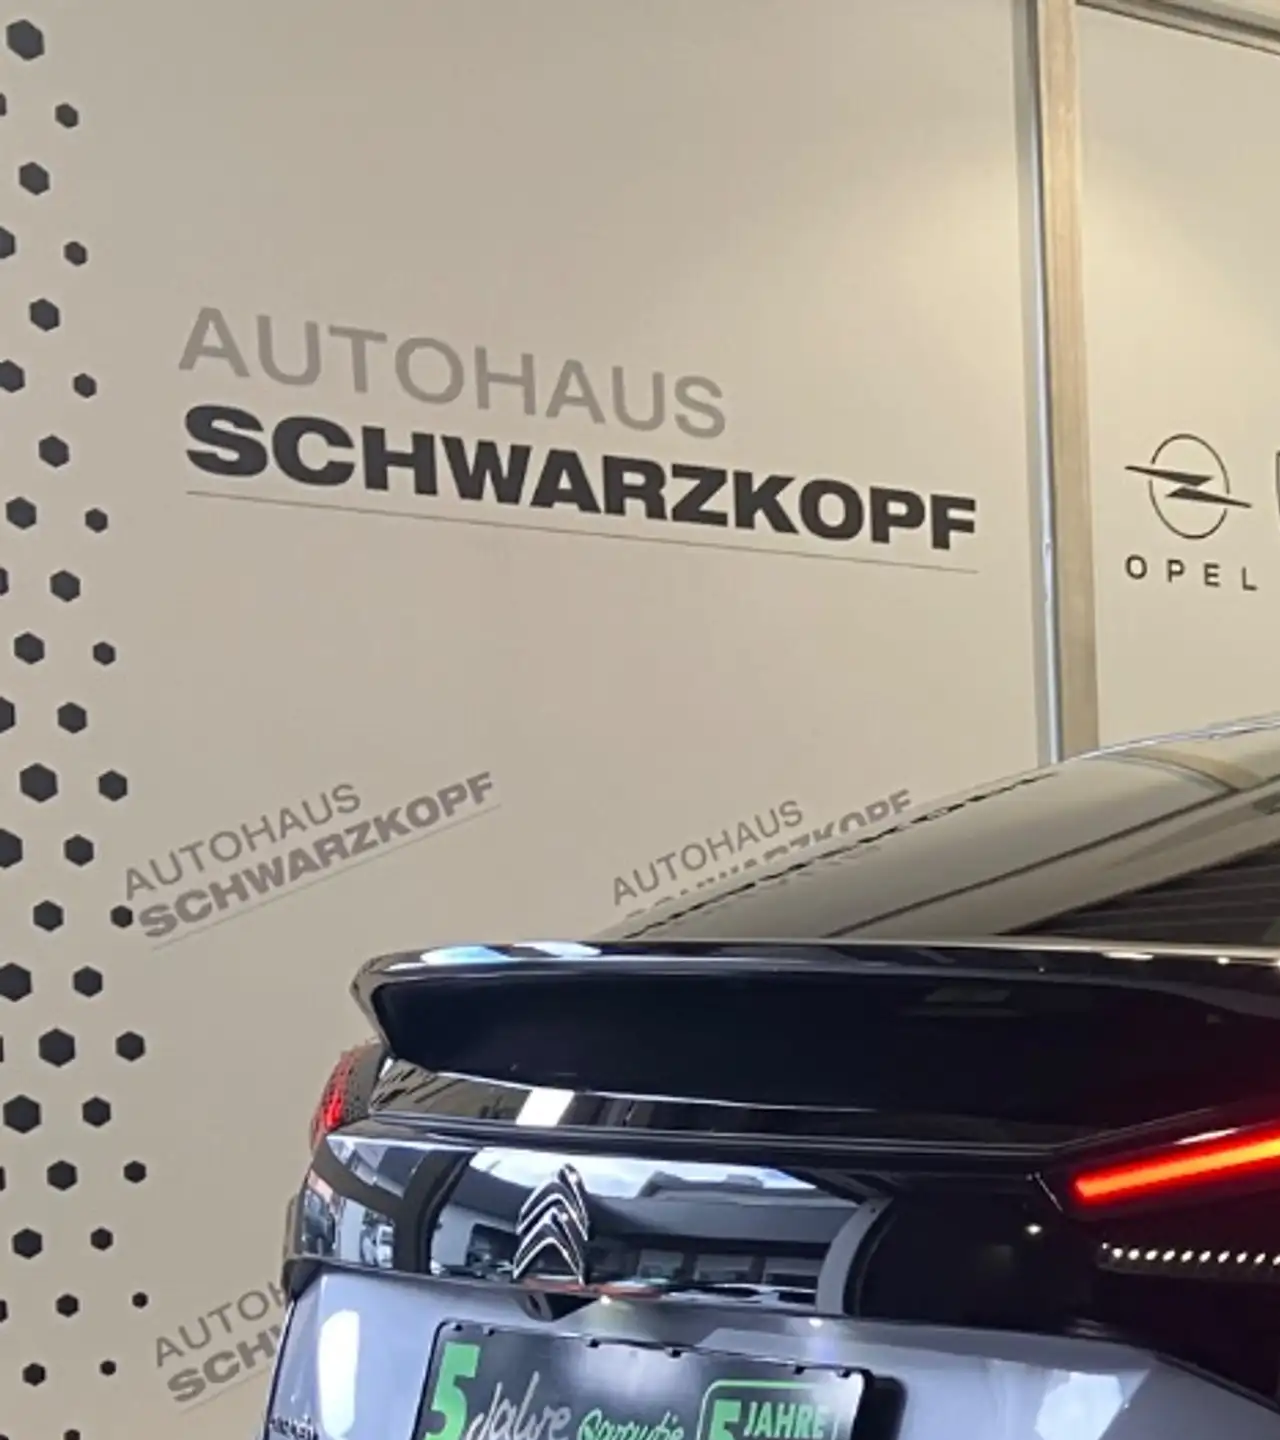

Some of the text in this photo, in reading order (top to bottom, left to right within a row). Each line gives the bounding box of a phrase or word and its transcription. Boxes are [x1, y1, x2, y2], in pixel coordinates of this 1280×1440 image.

[178, 306, 726, 438] AUTOHAUS
[185, 405, 978, 551] SCHWARZKOPF
[1125, 554, 1257, 591] OPEL
[125, 784, 361, 901] AUTOHAUS
[138, 772, 493, 938] SCHWARZKOPF
[611, 800, 803, 906] AUTOHAUS
[743, 1401, 829, 1440] JAHRE
